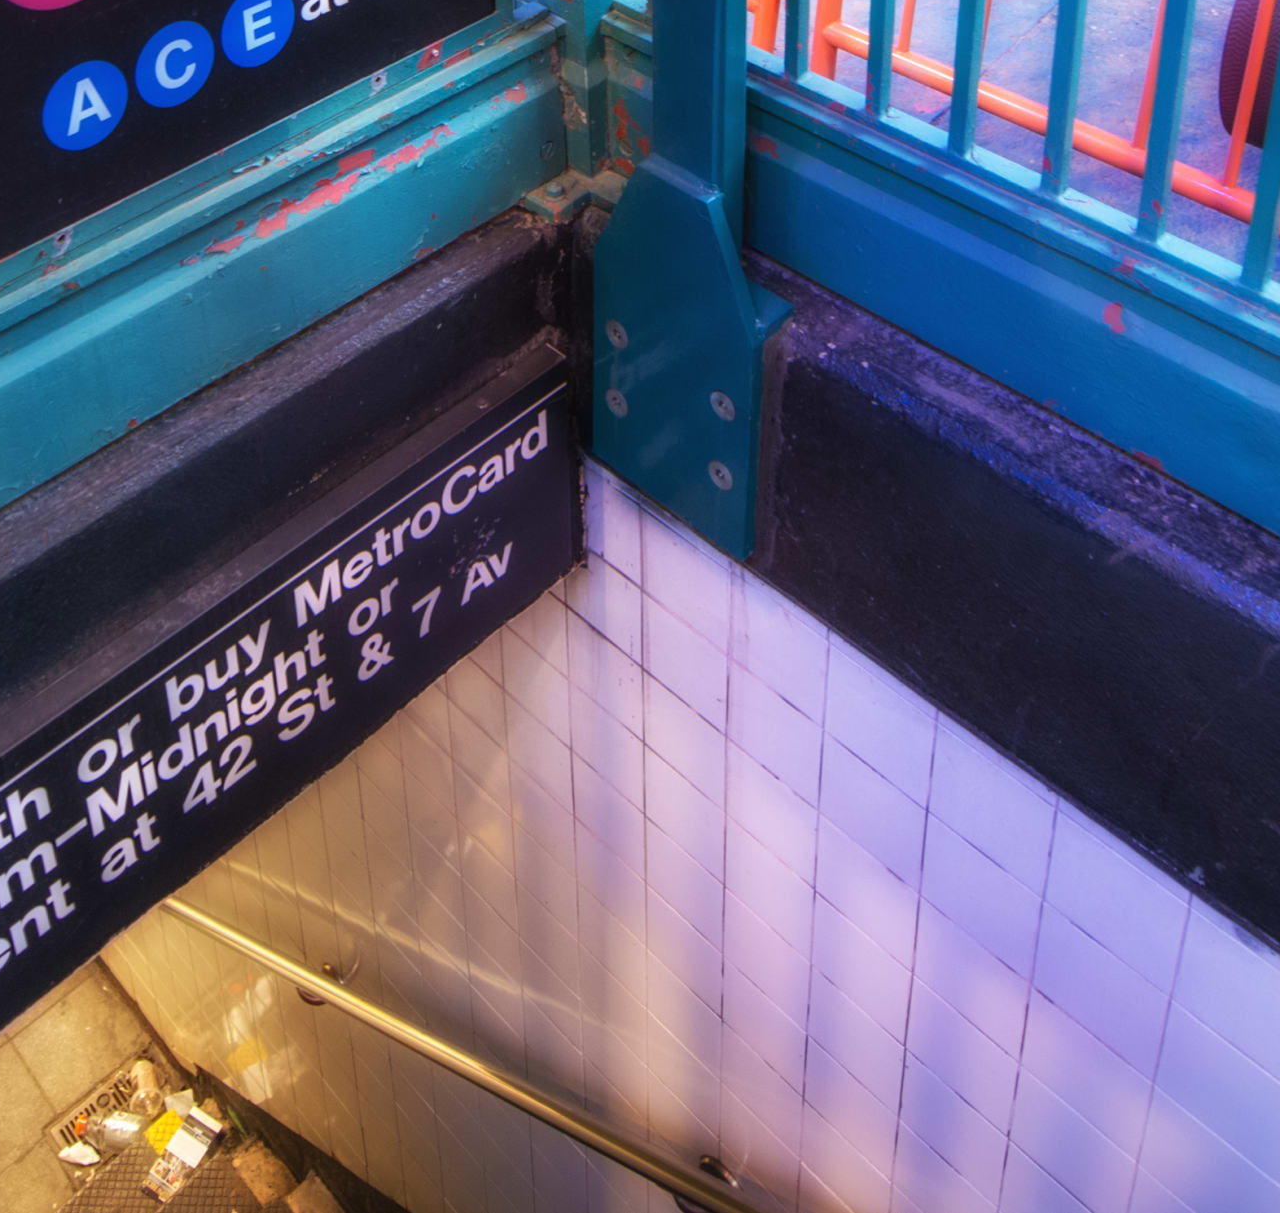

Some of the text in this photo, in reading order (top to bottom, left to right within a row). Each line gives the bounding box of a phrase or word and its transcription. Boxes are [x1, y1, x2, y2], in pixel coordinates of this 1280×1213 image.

[77, 713, 142, 784] or
[165, 619, 272, 722] buy
[292, 410, 549, 629] MetroCard
[100, 812, 162, 884] at
[181, 734, 258, 814] 42
[277, 673, 337, 743] St
[356, 632, 396, 682] &
[411, 586, 442, 639] 7
[460, 541, 514, 610] Av
[347, 577, 400, 637] or
